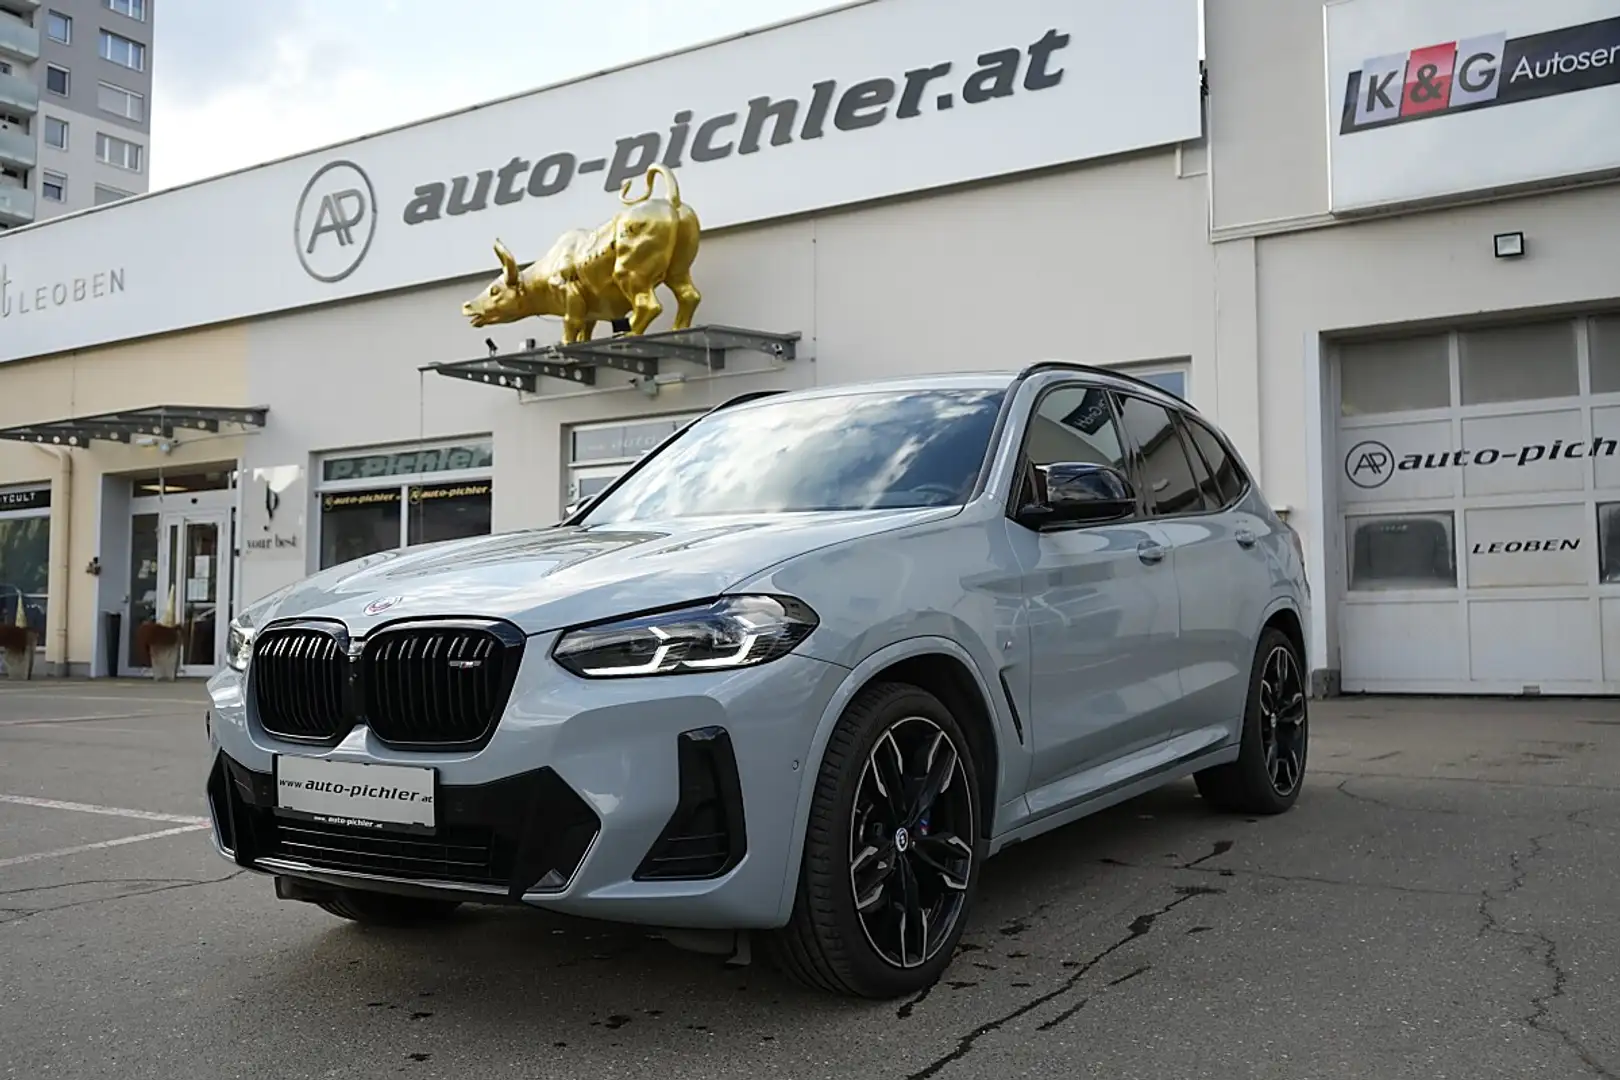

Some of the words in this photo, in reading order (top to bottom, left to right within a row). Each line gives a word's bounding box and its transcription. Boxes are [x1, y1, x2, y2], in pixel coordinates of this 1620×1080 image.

[1365, 52, 1497, 113] K&G
[1509, 44, 1620, 83] Autoser
[403, 28, 1071, 226] auto-pichler.at
[19, 267, 125, 314] LEOBEN
[1397, 436, 1618, 470] auto-pich
[0, 492, 36, 504] YCULT
[1472, 538, 1581, 554] LEOBEN
